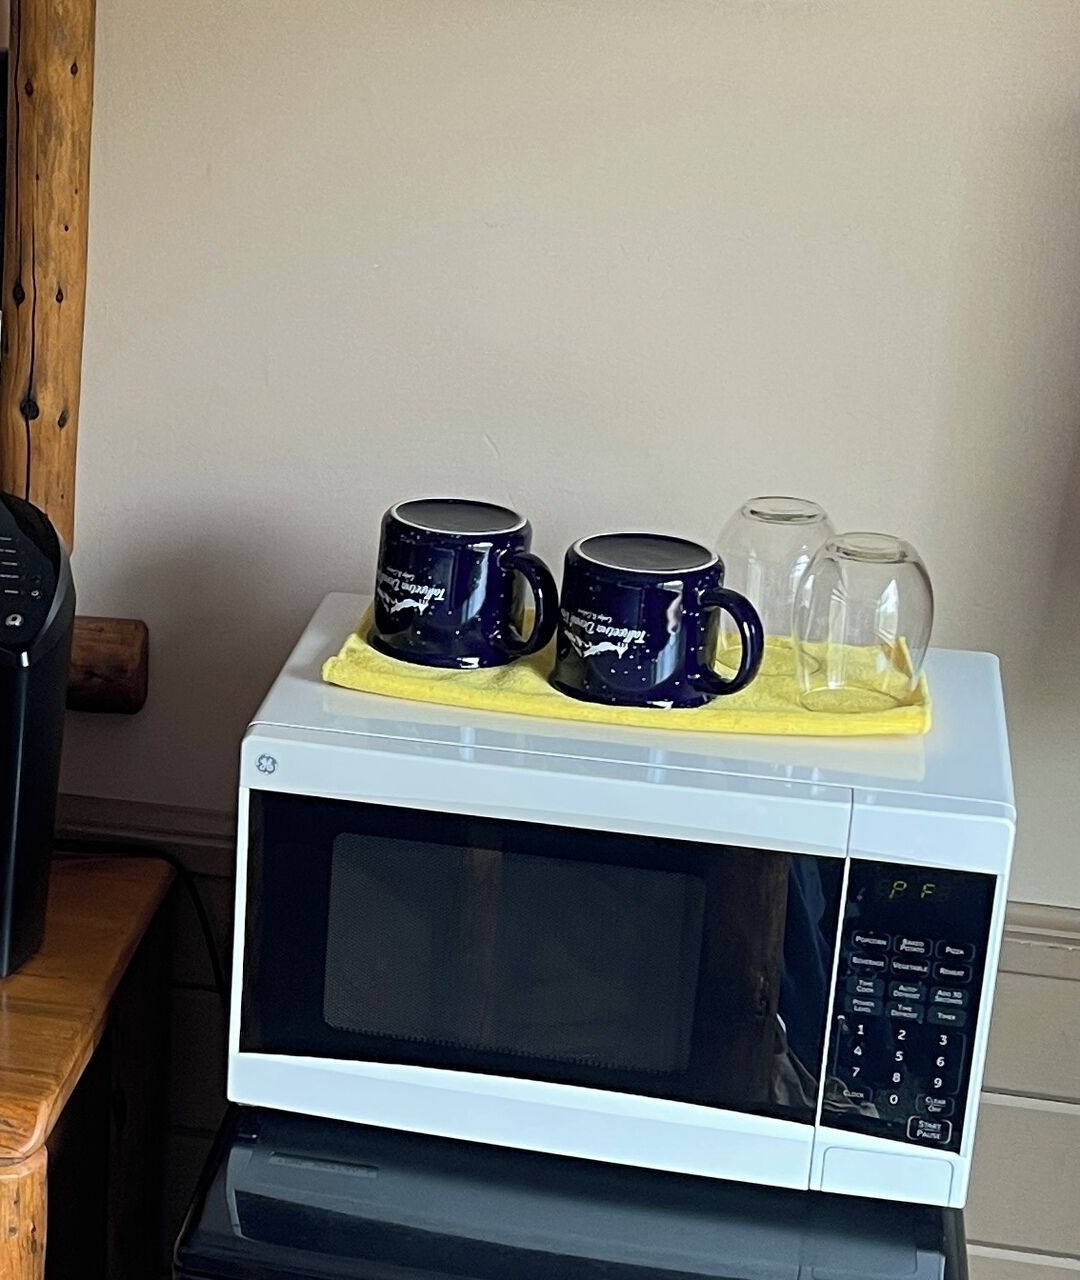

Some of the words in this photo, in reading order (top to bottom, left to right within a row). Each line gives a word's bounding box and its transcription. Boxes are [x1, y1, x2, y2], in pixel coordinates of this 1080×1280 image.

[857, 1024, 864, 1035] 1
[897, 1029, 907, 1041] 2
[939, 1034, 948, 1046] 3
[853, 1045, 862, 1056] 4
[894, 1050, 904, 1062] 5
[936, 1056, 945, 1067] 6
[852, 1066, 860, 1078] 7
[892, 1072, 901, 1083] 8
[933, 1077, 943, 1088] 9
[843, 1089, 864, 1098] CLOCK
[889, 1094, 899, 1105] 0
[918, 1120, 942, 1130] START
[916, 1129, 941, 1140] PAUSE
